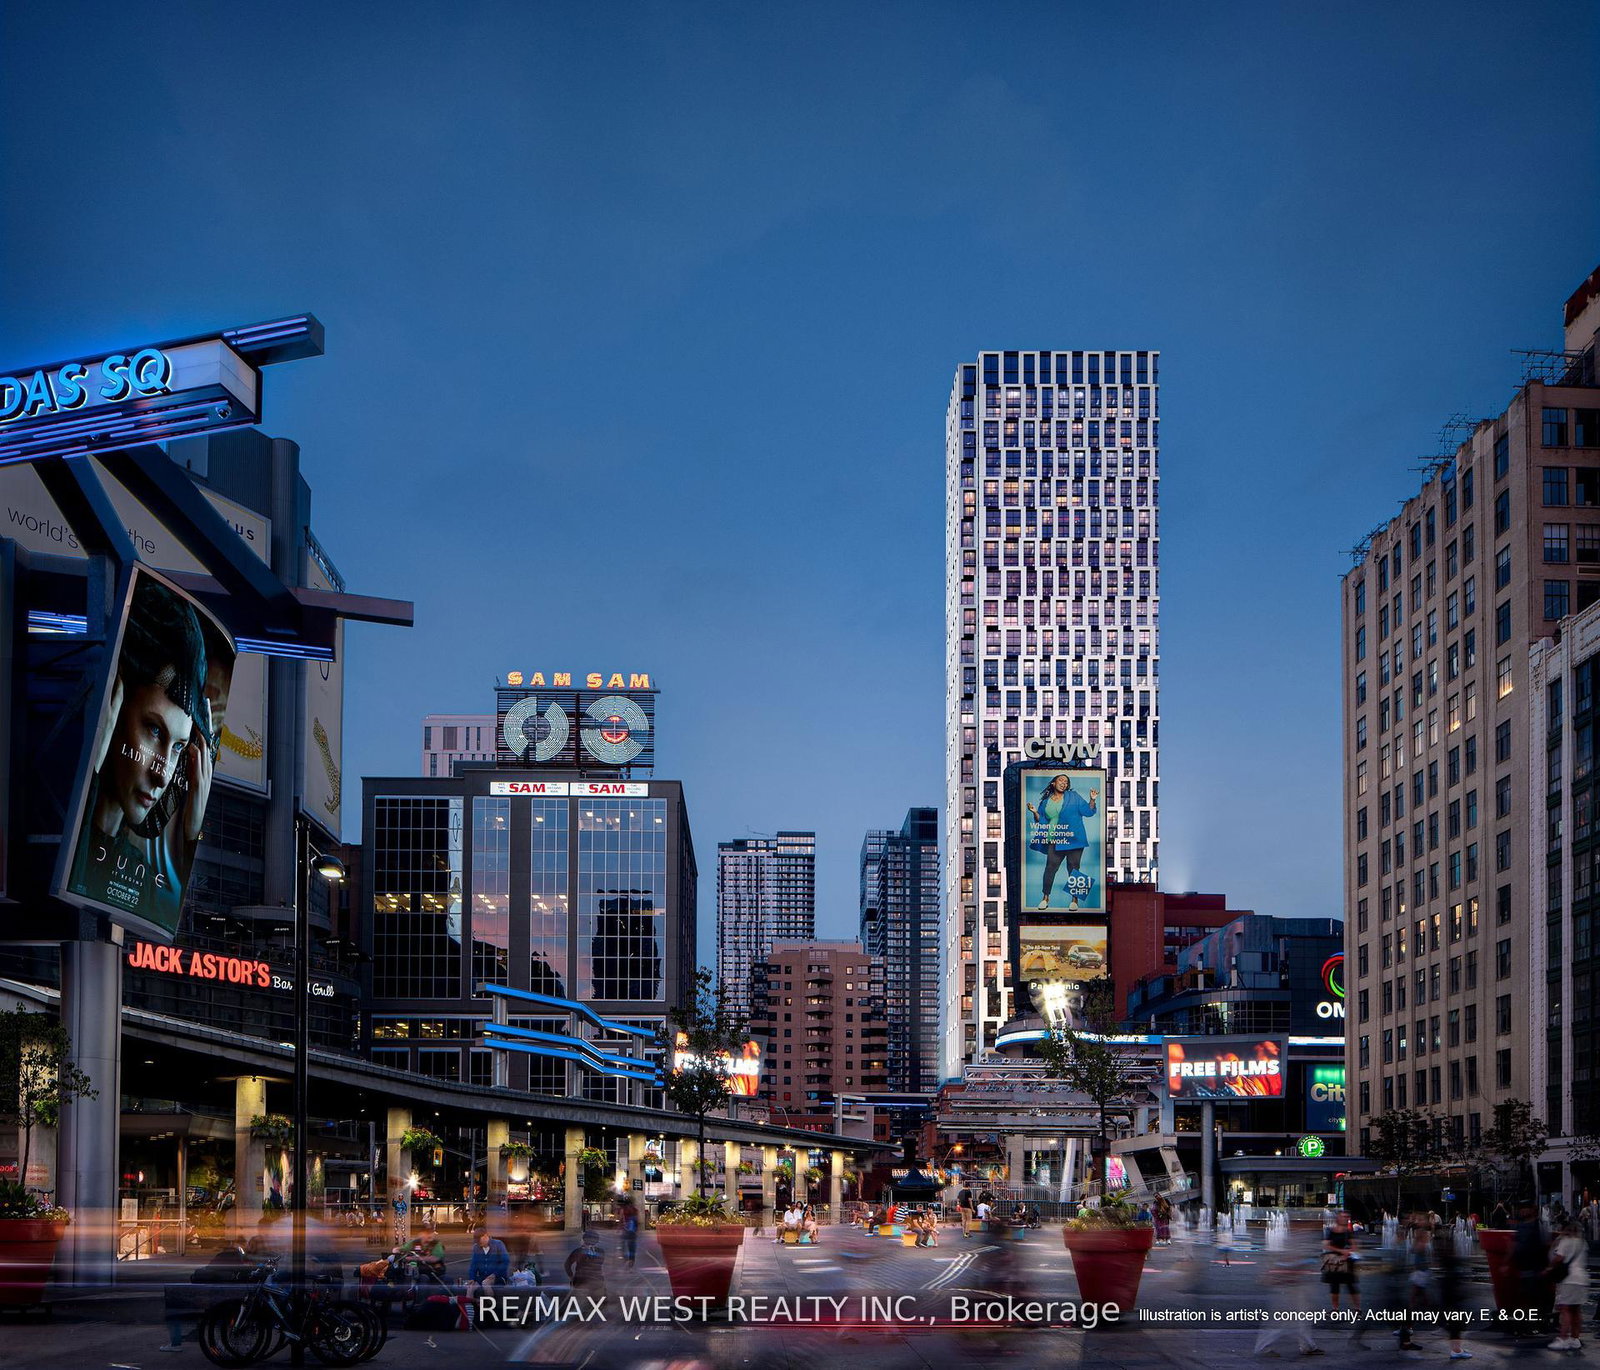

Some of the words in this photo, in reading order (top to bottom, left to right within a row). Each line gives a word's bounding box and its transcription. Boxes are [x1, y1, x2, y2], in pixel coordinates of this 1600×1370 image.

[100, 348, 169, 401] SQ
[7, 507, 79, 549] world's
[128, 528, 156, 554] the
[507, 671, 571, 687] SAM
[586, 672, 650, 689] SAM
[121, 743, 146, 766] LADY
[1024, 736, 1101, 763] Citytv
[509, 783, 546, 793] SAM
[588, 783, 626, 794] SAM
[1030, 822, 1051, 830] When
[1052, 823, 1069, 832] your
[1030, 830, 1049, 838] song
[1067, 875, 1092, 888] 98.1
[106, 886, 131, 901] OCTOBER
[129, 941, 183, 975] JACK
[189, 951, 271, 988] ASTOR'S
[272, 976, 293, 991] Bar
[312, 983, 335, 997] Grill
[1170, 1061, 1216, 1077] FREE
[1219, 1060, 1280, 1077] FILMS
[1307, 1141, 1318, 1152] P
